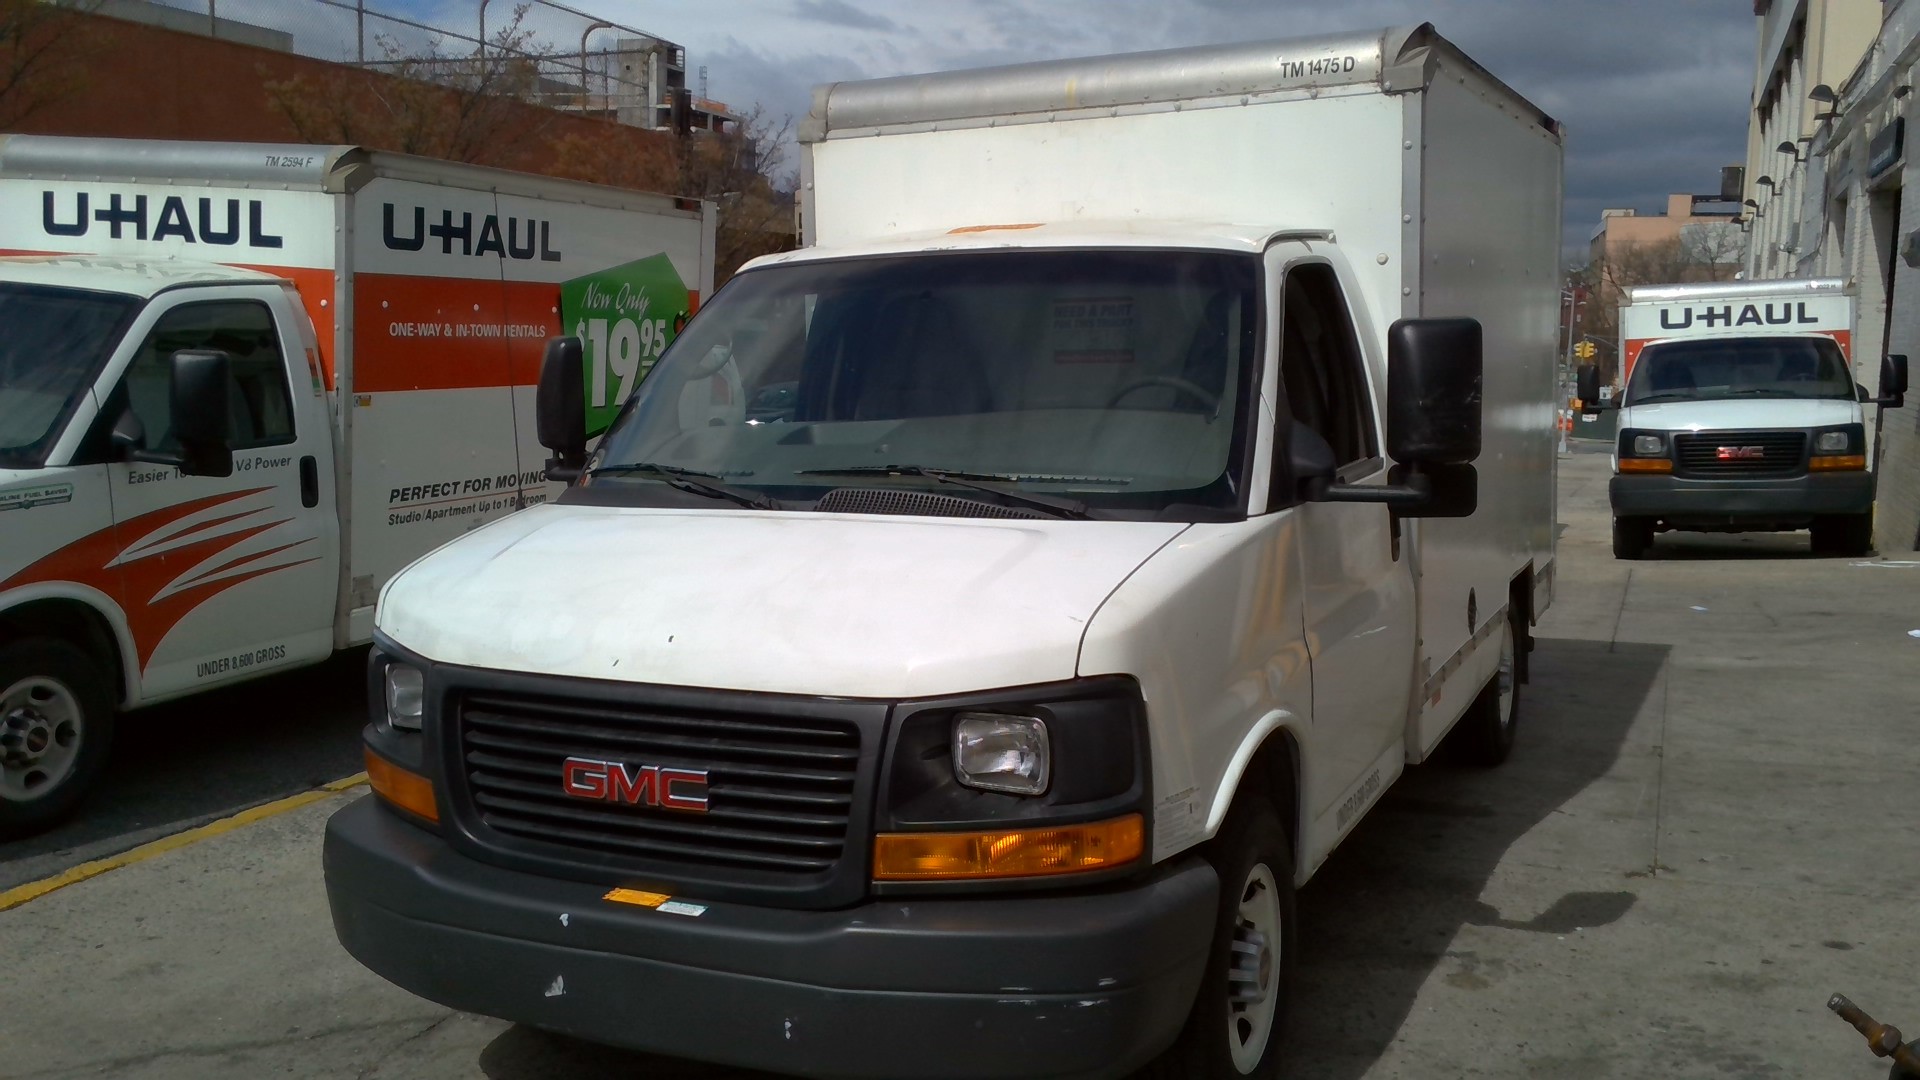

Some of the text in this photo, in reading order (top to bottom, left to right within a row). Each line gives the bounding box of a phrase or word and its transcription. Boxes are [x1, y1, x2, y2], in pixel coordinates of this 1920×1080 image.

[1281, 56, 1355, 78] TM 1475 D
[265, 156, 314, 168] TM 2594 F
[42, 190, 283, 248] U-HAUL
[383, 202, 561, 262] U-HAUL
[581, 282, 652, 320] Now Only
[1660, 302, 1818, 330] U-HAUL
[389, 322, 441, 337] ONE-WAY
[444, 323, 452, 337] &
[456, 323, 500, 338] IN-TOWN
[128, 468, 169, 484] Easier
[254, 456, 292, 470] Power
[389, 470, 546, 504] PERFECT FOR MOVING
[388, 506, 476, 526] Studio/Apartment
[478, 501, 490, 514] Up
[492, 499, 502, 510] to
[504, 498, 508, 508] 1
[196, 644, 286, 678] UNDER 8,600 GROSS
[563, 756, 709, 812] GMC
